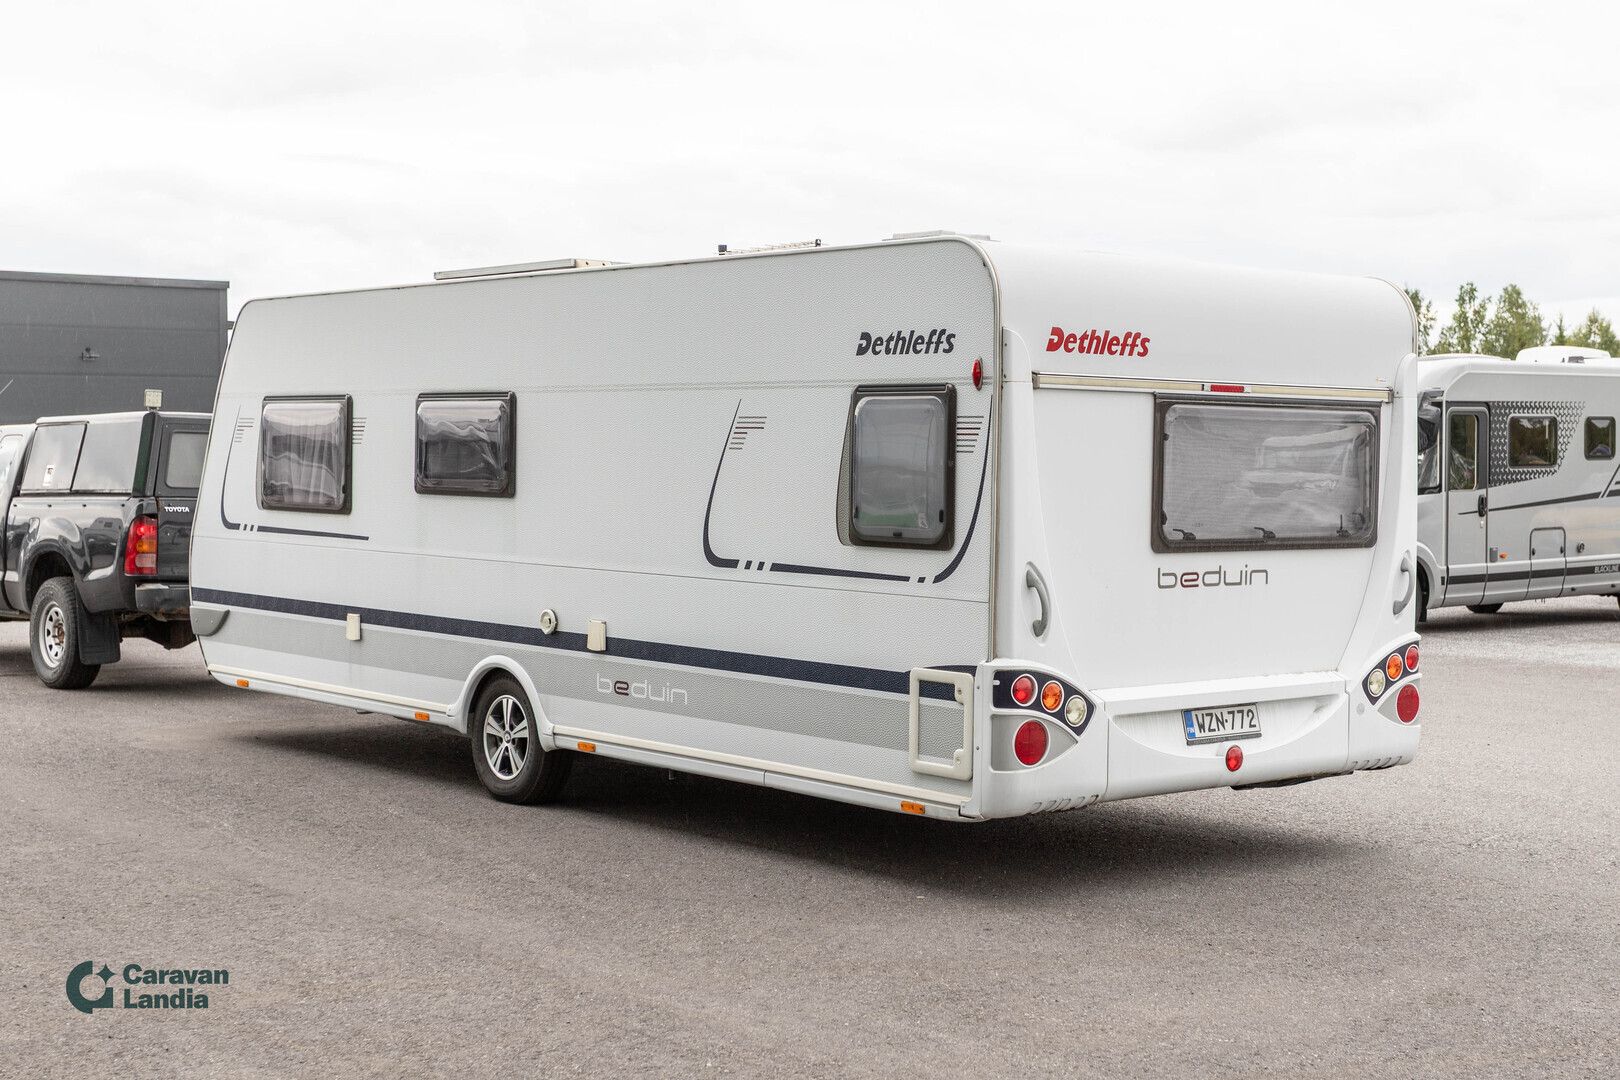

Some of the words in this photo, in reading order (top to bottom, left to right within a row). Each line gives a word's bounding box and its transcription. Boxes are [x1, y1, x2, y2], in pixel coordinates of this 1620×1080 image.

[856, 329, 956, 356] Dethleffs
[1046, 327, 1151, 357] Dethleffs
[1157, 564, 1269, 589] beduin
[596, 672, 687, 705] beduin
[1195, 708, 1257, 734] WZN-772
